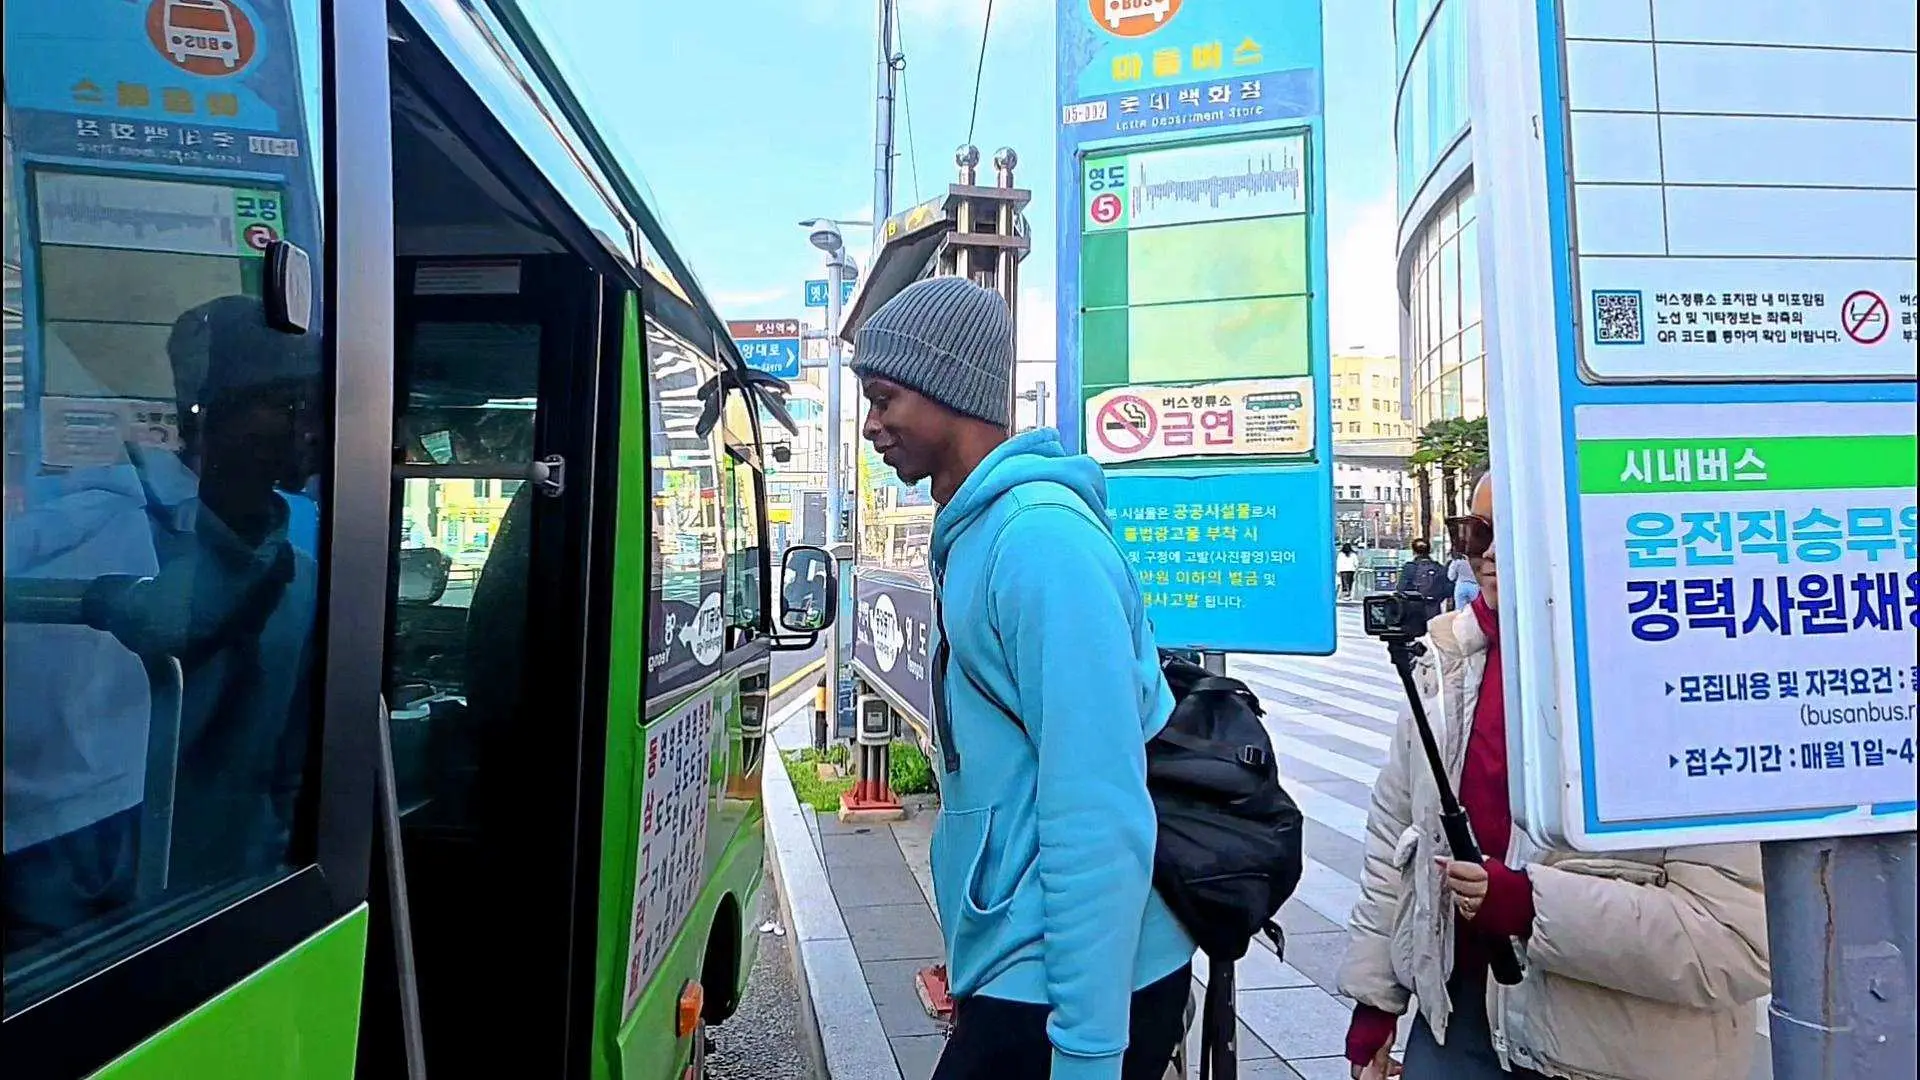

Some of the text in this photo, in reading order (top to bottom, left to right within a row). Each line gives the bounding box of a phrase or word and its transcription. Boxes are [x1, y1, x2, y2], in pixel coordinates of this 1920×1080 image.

[1112, 37, 1263, 82] 마을버스
[1119, 80, 1261, 114] 롯데백화점
[1229, 104, 1264, 118] Store
[1088, 165, 1125, 191] 영도
[1097, 198, 1115, 219] 5
[1656, 293, 1825, 307] 버스정류소 표지판 내 미포함된
[1657, 312, 1681, 325] 노선
[1685, 312, 1698, 325] 및
[1767, 312, 1803, 325] 좌측의
[755, 323, 785, 335] 부산역
[1657, 330, 1841, 344] QR 코드를 통하여 확인 바랍니다.
[737, 344, 780, 359] 앙대로
[1162, 394, 1232, 409] 버스정류소
[1161, 410, 1234, 446] 금연
[1620, 447, 1768, 485] 시내버스
[1122, 507, 1170, 520] 시설물은
[1173, 502, 1277, 520] 공공시설물로서
[1206, 526, 1237, 542] 부착
[1243, 526, 1259, 542] 시
[1145, 551, 1181, 564] 구청에
[1175, 570, 1221, 586] 이하의
[1263, 572, 1277, 587] 및
[1626, 572, 1917, 642] 경력사원채
[1679, 671, 1772, 703] 모집내용
[1777, 670, 1799, 699] 및
[1806, 666, 1893, 697] 자격요건
[1685, 744, 1783, 778] 접수기간
[1801, 741, 1845, 771] 매월
[1850, 737, 1917, 768] 1일~4
